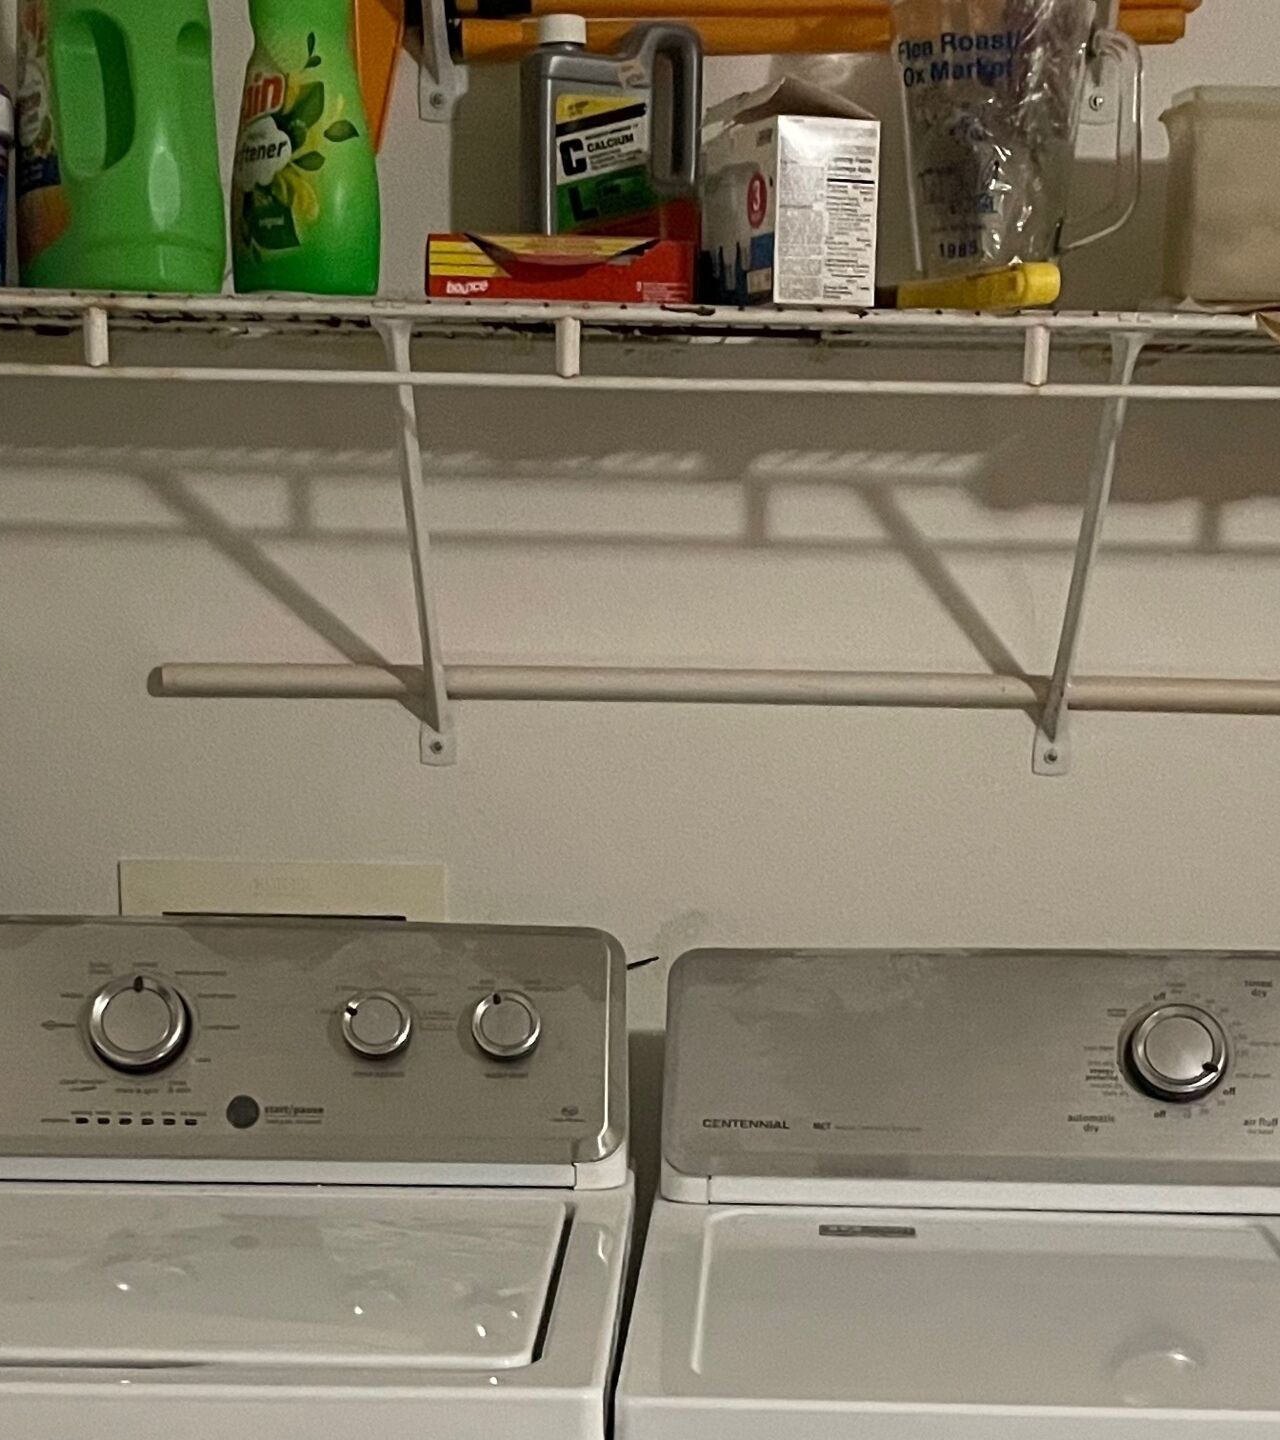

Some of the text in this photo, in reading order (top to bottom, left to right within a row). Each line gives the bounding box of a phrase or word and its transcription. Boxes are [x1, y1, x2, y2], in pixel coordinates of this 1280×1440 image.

[898, 40, 933, 60] Flea
[931, 57, 1012, 82] Market
[586, 133, 634, 153] CALCIUM
[559, 138, 588, 177] C
[752, 179, 761, 212] 3
[567, 186, 599, 222] L
[1251, 988, 1267, 998] dry
[1222, 1087, 1236, 1096] off
[1067, 1114, 1115, 1123] automatic
[1154, 1110, 1167, 1119] off
[702, 1118, 790, 1130] CENTENNIAL
[1082, 1123, 1100, 1133] dry
